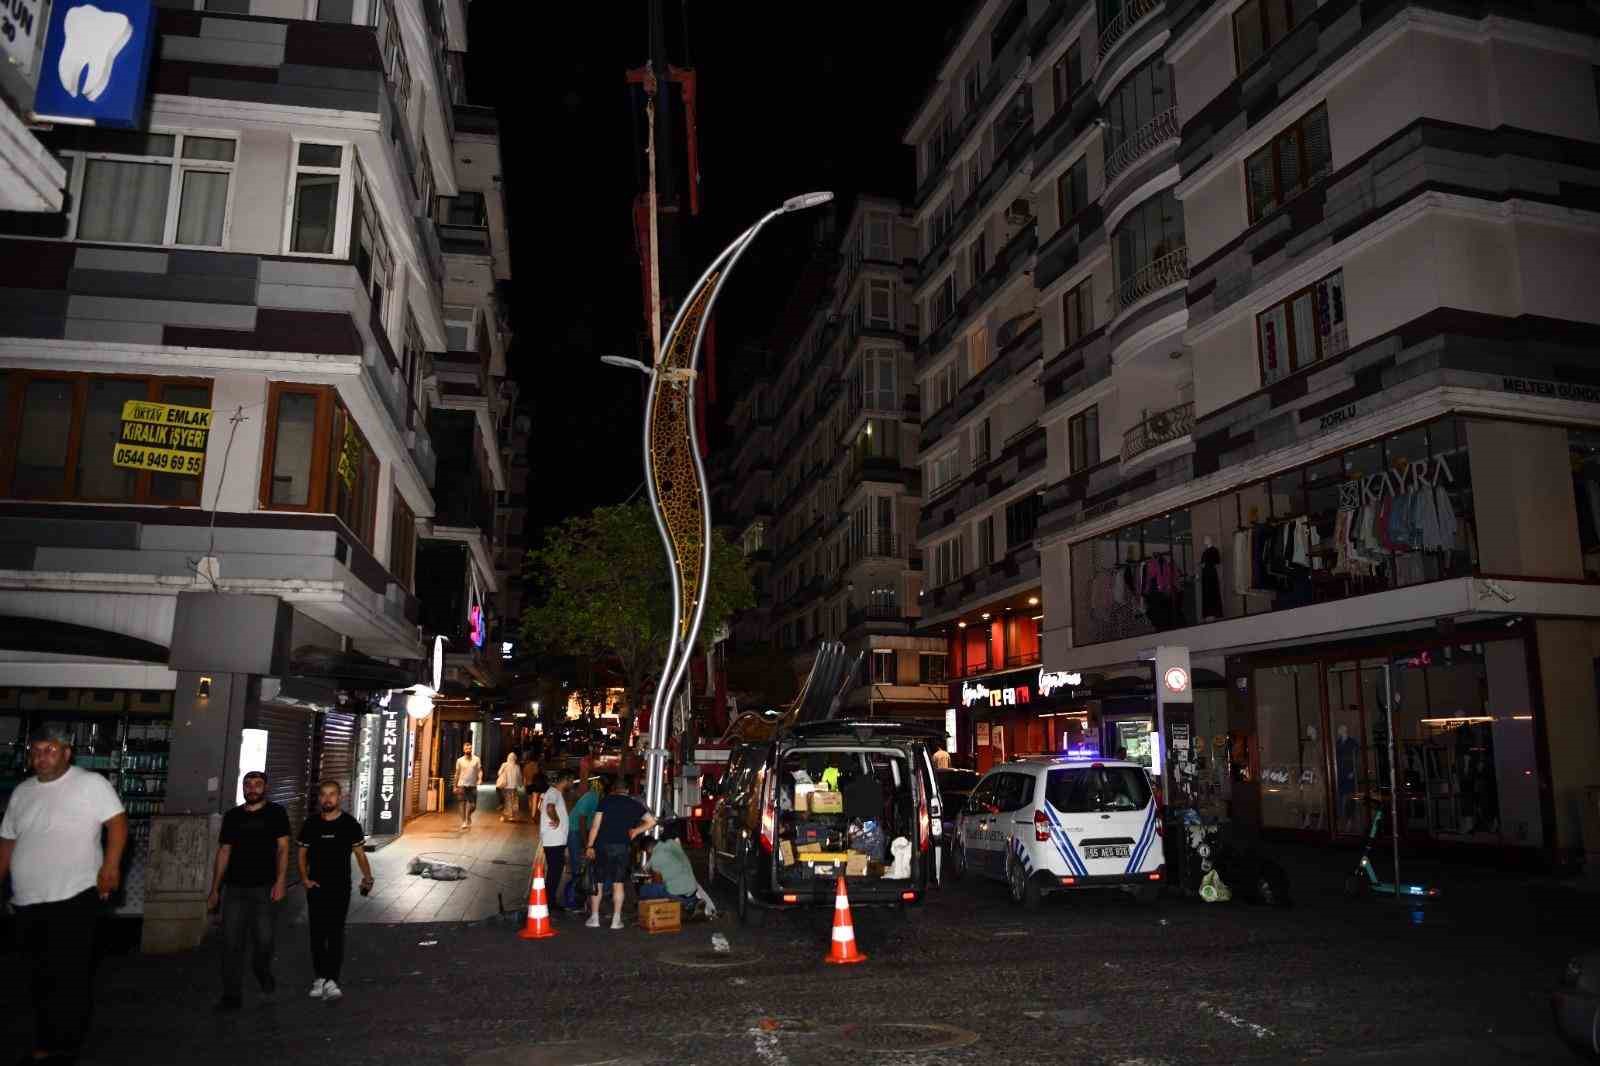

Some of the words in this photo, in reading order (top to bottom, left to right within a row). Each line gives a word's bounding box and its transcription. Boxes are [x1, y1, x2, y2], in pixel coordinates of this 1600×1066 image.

[167, 409, 209, 426] EMLAK
[1319, 404, 1356, 430] ZORLU
[123, 422, 168, 444] KIRALIK
[117, 448, 144, 465] 0544
[147, 452, 168, 469] 949
[171, 455, 185, 470] 69
[187, 457, 201, 472] 55
[1360, 455, 1454, 504] KAYRA
